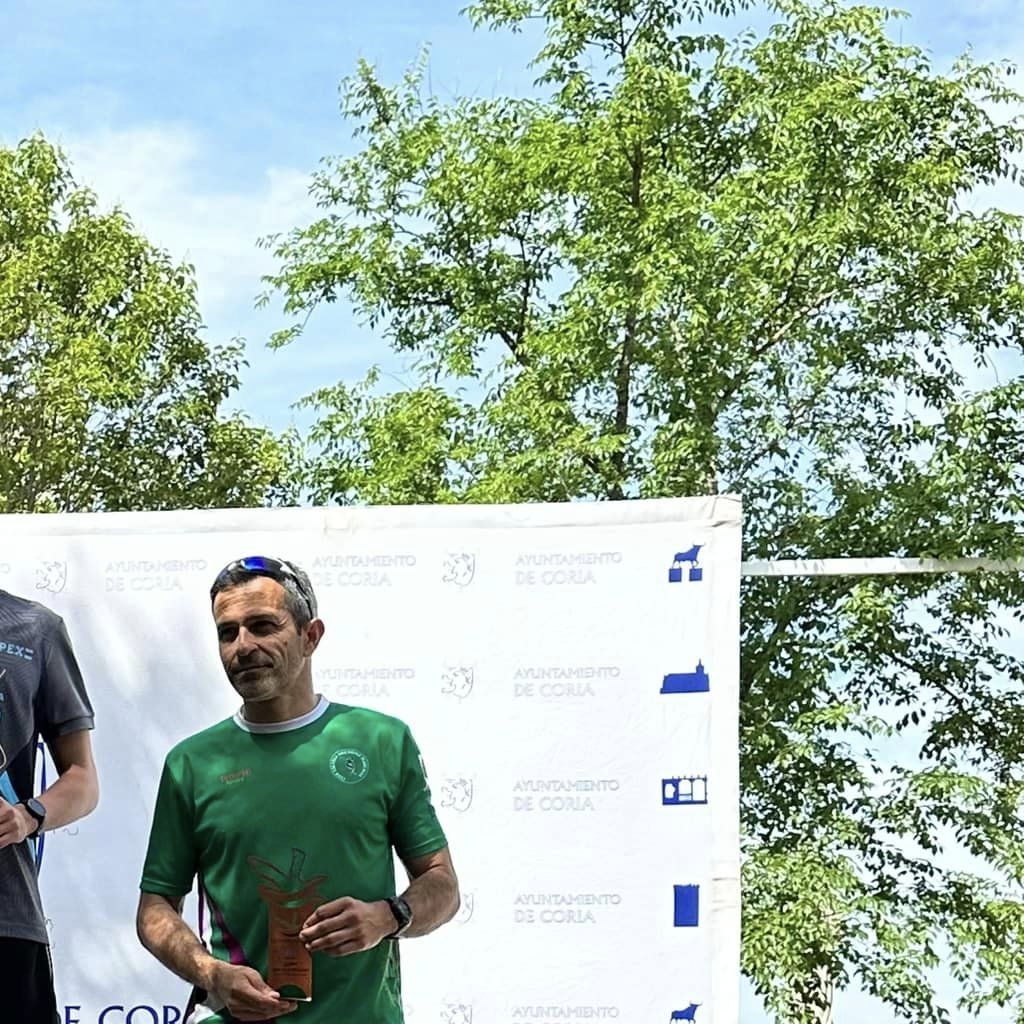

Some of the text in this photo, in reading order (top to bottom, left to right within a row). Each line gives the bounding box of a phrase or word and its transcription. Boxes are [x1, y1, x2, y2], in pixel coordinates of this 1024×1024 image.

[514, 552, 623, 566] AYUNTAMIENTO
[515, 570, 597, 586] DE CORIA
[514, 666, 621, 680] AYUNTAMIENTO
[514, 682, 596, 698] DE CORIA
[513, 779, 620, 792] AYUNTAMIENTO
[513, 796, 595, 812] DE CORIA
[514, 894, 622, 906] AYUNTAMIENTO
[514, 909, 596, 924] DE CORIA
[512, 1006, 620, 1019] AYUNTAMIENTO
